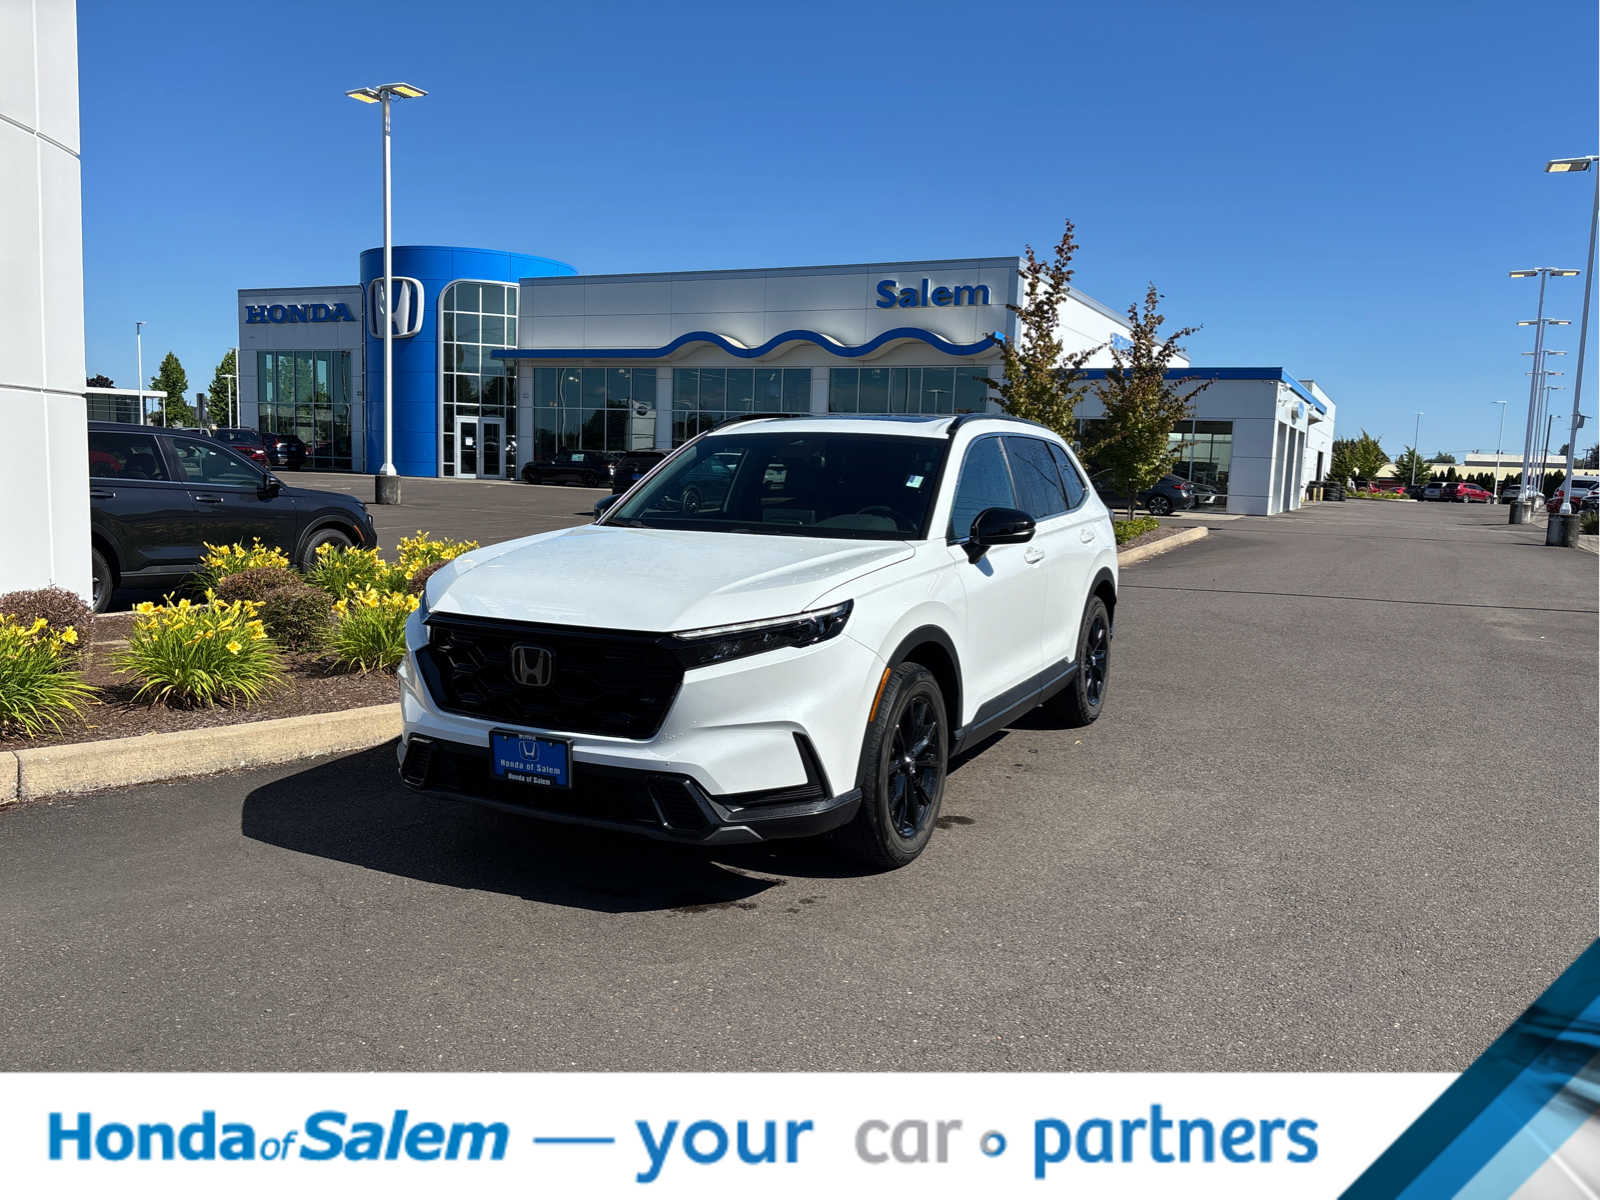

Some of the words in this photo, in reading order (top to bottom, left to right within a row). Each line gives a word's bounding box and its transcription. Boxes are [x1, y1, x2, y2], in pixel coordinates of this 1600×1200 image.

[876, 278, 990, 308] Salem
[245, 302, 356, 324] HONDA
[500, 759, 523, 769] Honda
[526, 763, 534, 771] of
[536, 764, 561, 775] Salem
[508, 773, 525, 781] Honda
[533, 776, 551, 785] Salem
